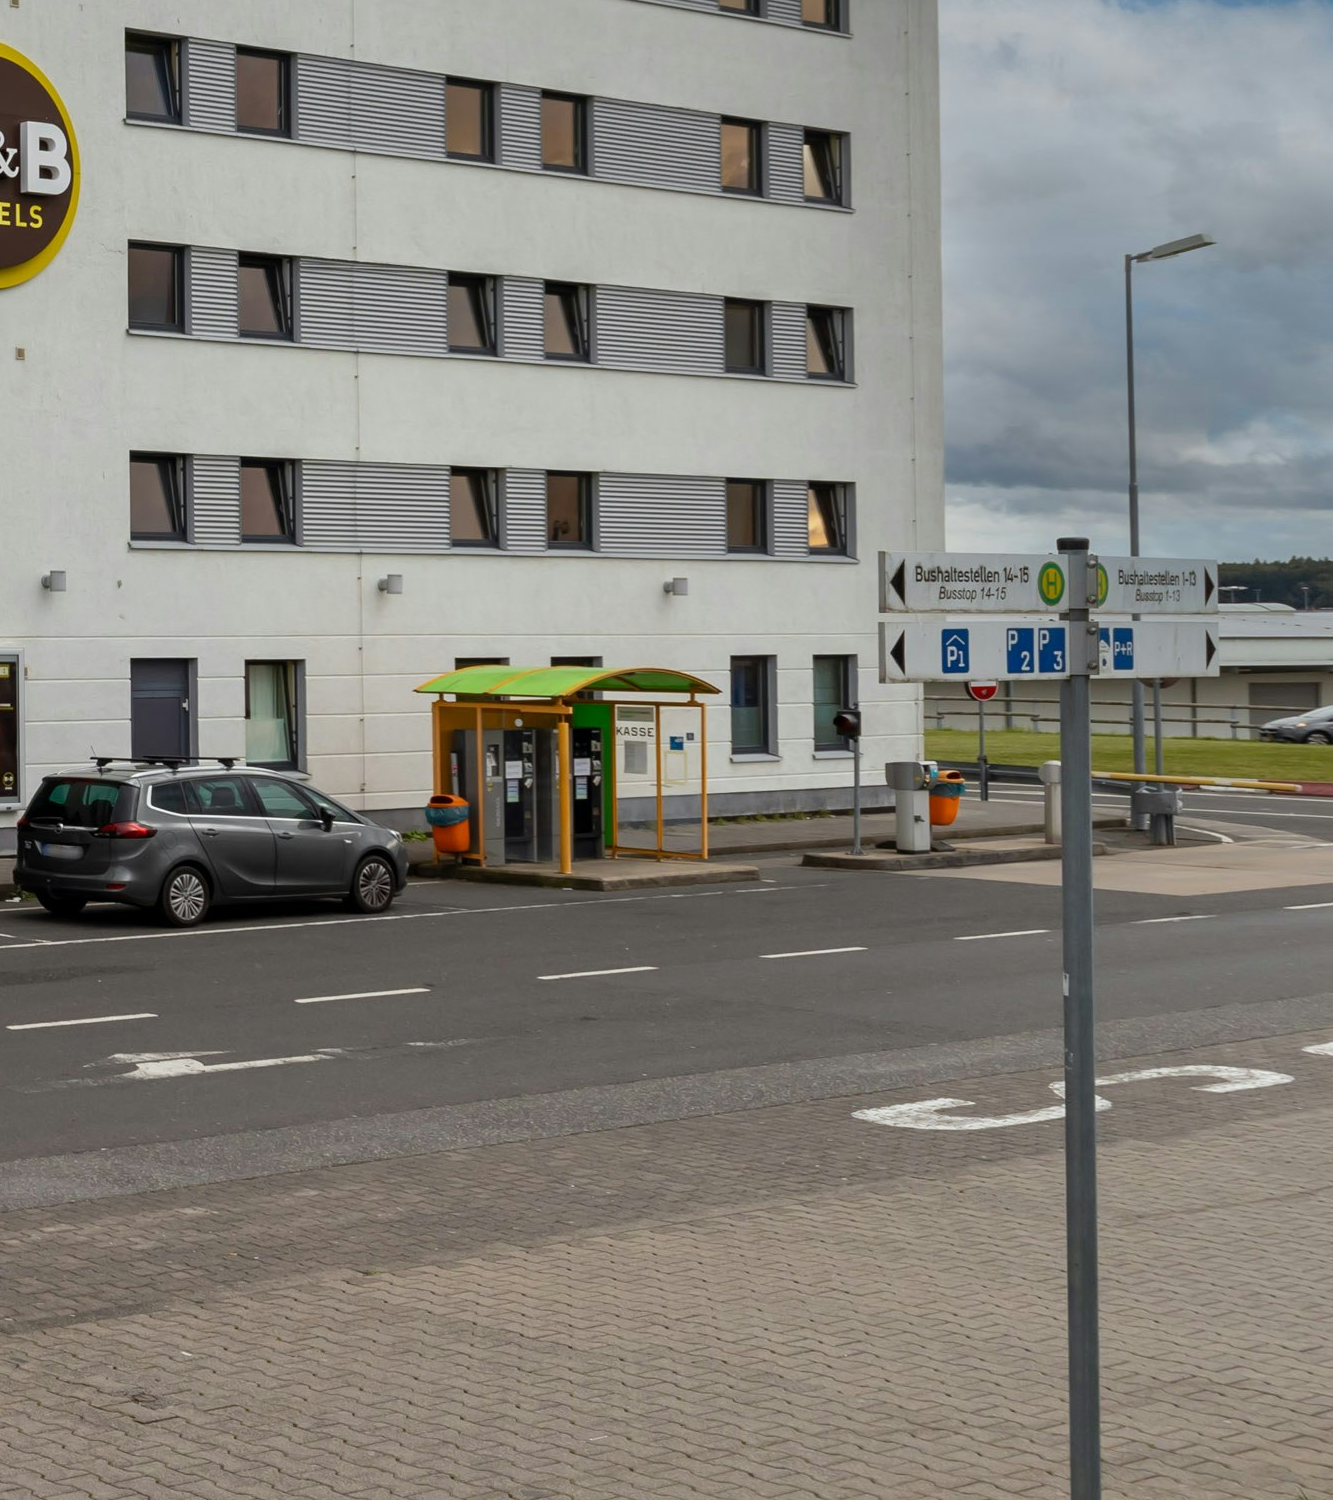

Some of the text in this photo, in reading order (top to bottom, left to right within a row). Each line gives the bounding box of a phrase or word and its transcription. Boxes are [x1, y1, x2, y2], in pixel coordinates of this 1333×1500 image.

[915, 565, 1030, 584] Bushaltestellen 14-15
[1118, 570, 1180, 586] Bushaltestellen
[1182, 571, 1197, 587] 1-13
[939, 586, 1007, 603] Busstop 14-15
[1135, 589, 1163, 604] Busstop
[1115, 642, 1133, 656] P+R
[616, 727, 655, 737] KASSE
